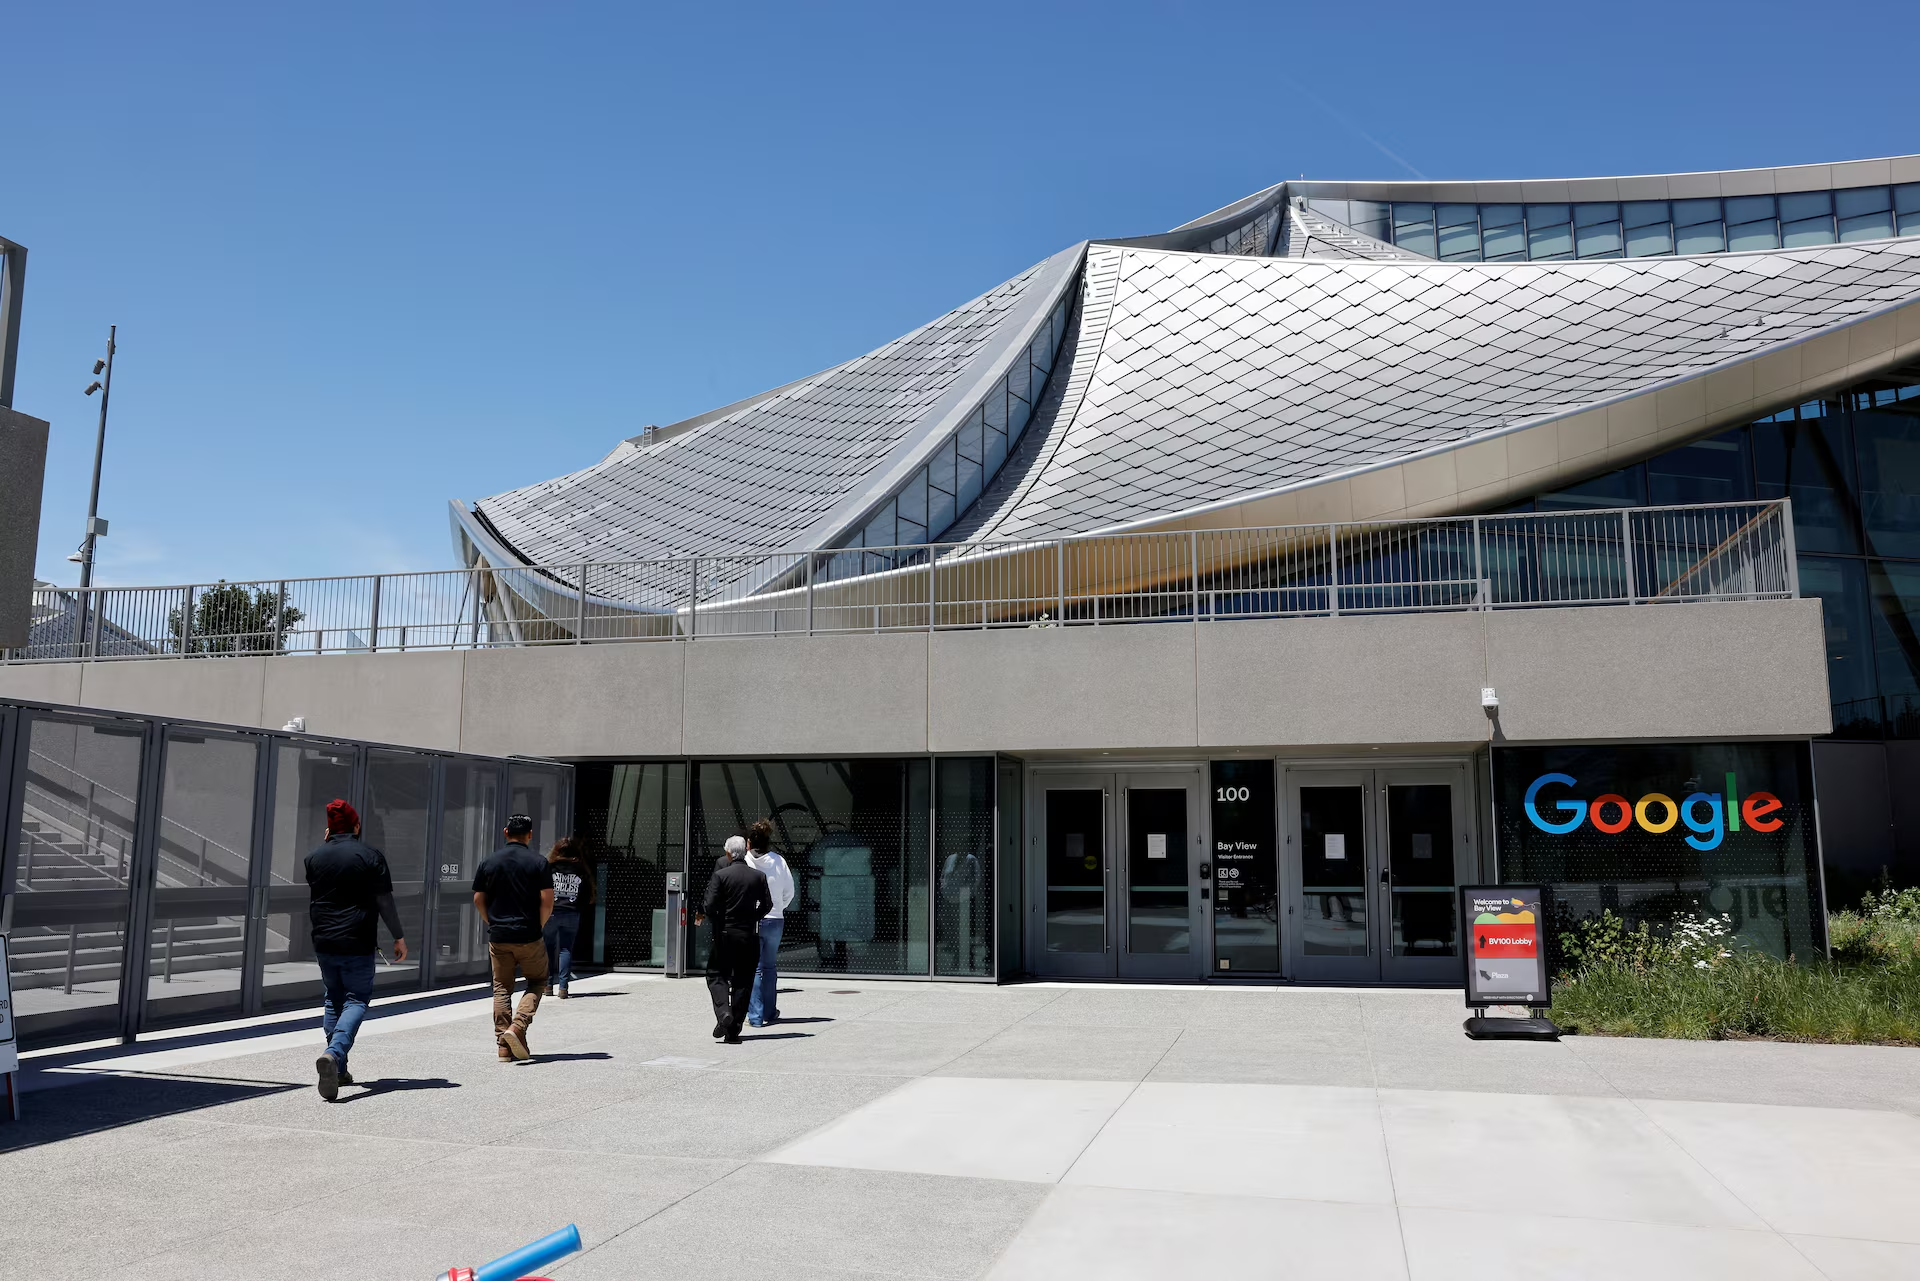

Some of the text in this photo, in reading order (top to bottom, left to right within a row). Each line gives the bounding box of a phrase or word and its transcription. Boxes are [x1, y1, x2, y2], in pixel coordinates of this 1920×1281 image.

[1217, 787, 1250, 801] 100
[1524, 772, 1784, 850] Google
[1217, 842, 1257, 852] Bay View
[1512, 938, 1532, 946] Lobby
